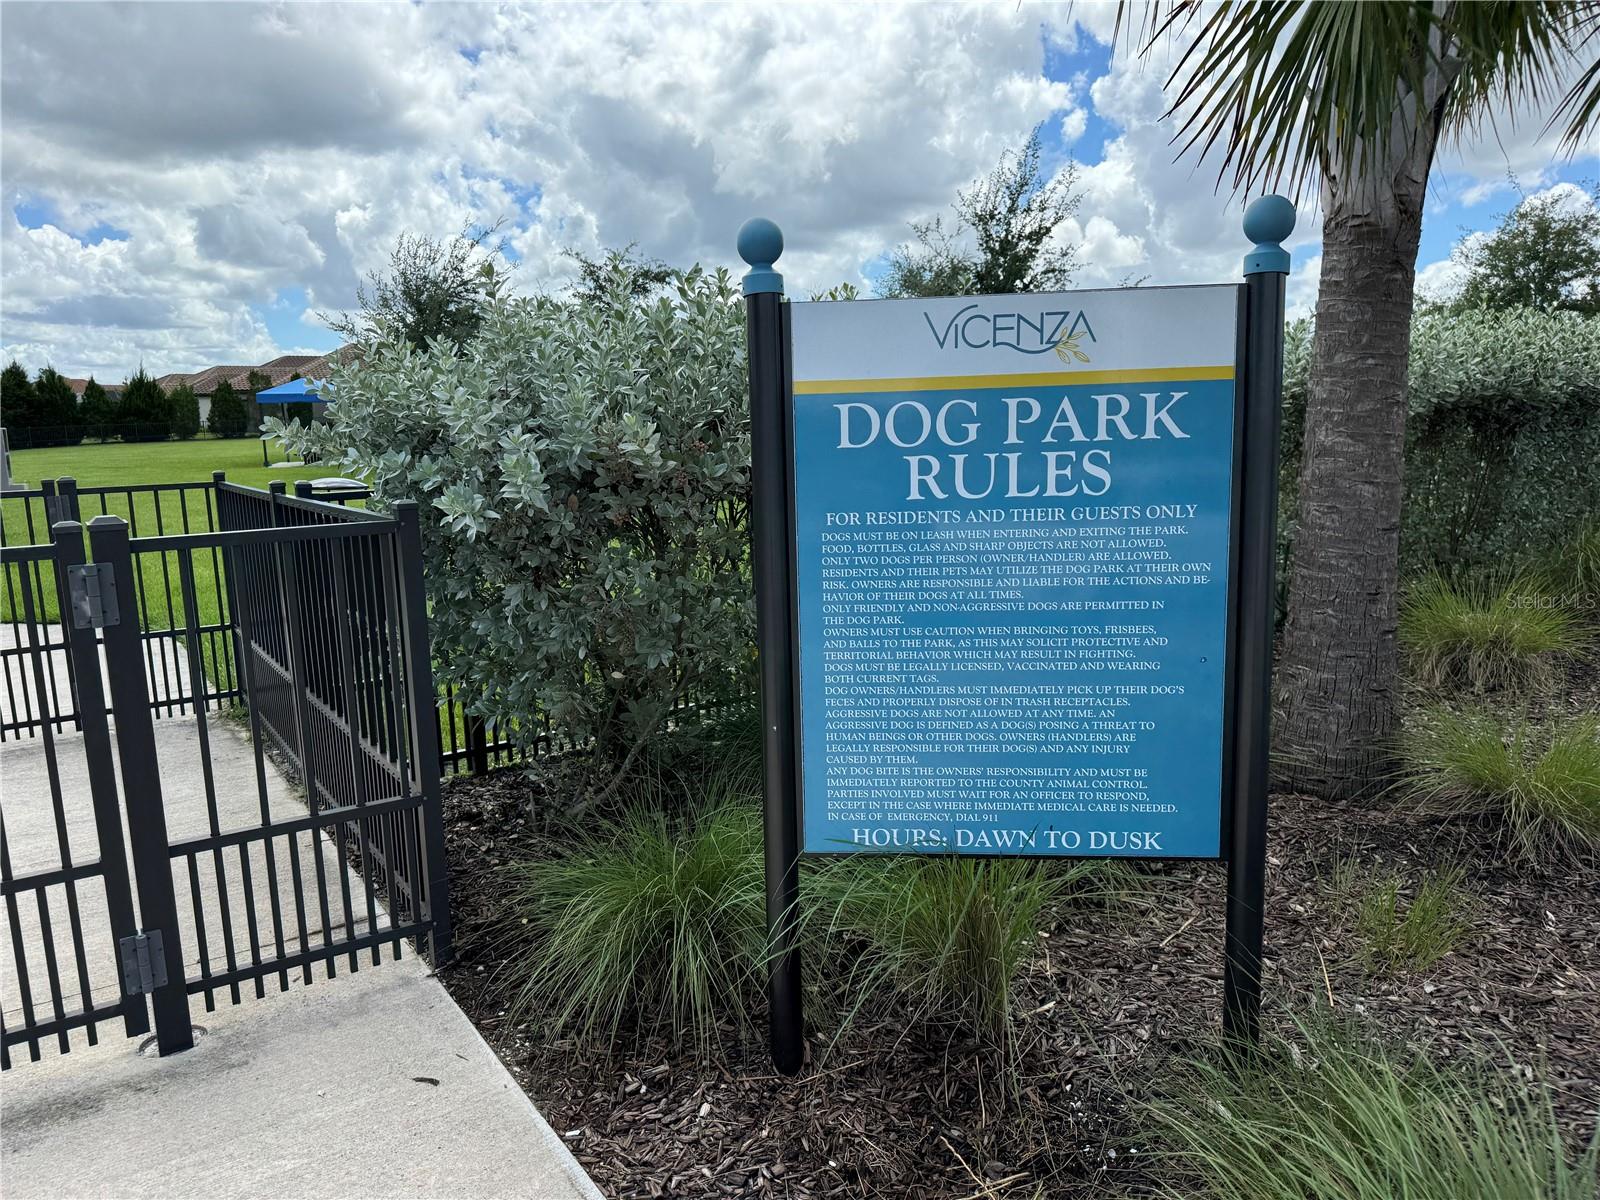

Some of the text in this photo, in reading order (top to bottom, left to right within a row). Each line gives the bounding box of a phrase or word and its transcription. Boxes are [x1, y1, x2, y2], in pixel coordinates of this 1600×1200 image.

[833, 391, 1191, 450] DOG PARK
[903, 449, 1112, 501] RULES
[826, 504, 1197, 525] FOR RESIDENTS AND THEIR GUESTS ONLY
[821, 525, 1188, 541] DOGS MUST BE ON LEASH WHEN ENTERING AND EXITING THE PARK.
[822, 538, 1166, 553] FOOD, BOTTLES, GLASS AND SHARP OBJECTS ARE NOT ALLOWED.
[821, 550, 1171, 565] ONLY TWO DOGS PER PERSON (OWNER/HANDLER) ARE ALLOWED.
[823, 590, 1023, 601] HAVIOR OF THEIR DOGS AT ALL TIMES.
[822, 600, 1164, 613] ONLY FRIENDLY AND NON-AGGRESSIVE DOGS ARE PERMITTED IN
[823, 625, 1156, 636] OWNERS MUST USE CAUTION WHEN BRINGING TOYS, FRISBEES,
[823, 649, 1135, 659] TERRITORIAL BEHAVIOR WHICH MAY RESULT IN FIGHTING.
[824, 661, 1161, 671] DOGS MUST BE LEGALLY LICENSED, VACCINATED AND WEARING
[824, 674, 938, 683] BOTH CURRENT TAGS.
[825, 685, 1184, 694] DOG OWNERS/HANDLERS MUST IMMEDIATELY PICK UP THEIR DOG'S
[825, 697, 1130, 706] FECES AND PROPERLY DISPOSE OF IN TRASH RECEPTACLES.
[825, 709, 1115, 717] AGGRESSIVE DOGS ARE NOT ALLOWED AT ANY TIME. AN
[826, 732, 1136, 741] HUMAN BEINGS OR OTHER DOGS. OWNERS (HANDLERS) ARE
[826, 744, 870, 752] LEGALLY
[873, 744, 941, 752] RESPONSIBLE
[944, 744, 964, 752] FOR
[966, 744, 999, 752] THEIR
[1002, 744, 1037, 752] DOG(S)
[1039, 744, 1063, 752] AND
[1091, 745, 1129, 754] INJURY
[826, 755, 917, 763] CAUSED BY THEM.
[827, 778, 897, 786] IMMEDIATELY
[900, 778, 955, 786] REPORTED
[975, 779, 996, 787] THE
[999, 779, 1044, 787] COUNTY
[1046, 779, 1089, 788] ANIMAL
[1091, 780, 1147, 788] CONTROL.
[827, 789, 868, 797] PARTIES
[871, 790, 924, 798] INVOLVED
[927, 790, 956, 798] MUST
[958, 790, 987, 798] WAIT
[989, 790, 1010, 798] FOR
[1030, 791, 1075, 799] OFFICER
[1077, 791, 1093, 799] TO
[1095, 791, 1149, 801] RESPOND,
[827, 812, 997, 821] IN CASE OF EMERGENCY, DIAL 911
[852, 828, 1163, 849] HOURS: DAWN TO DUSK
